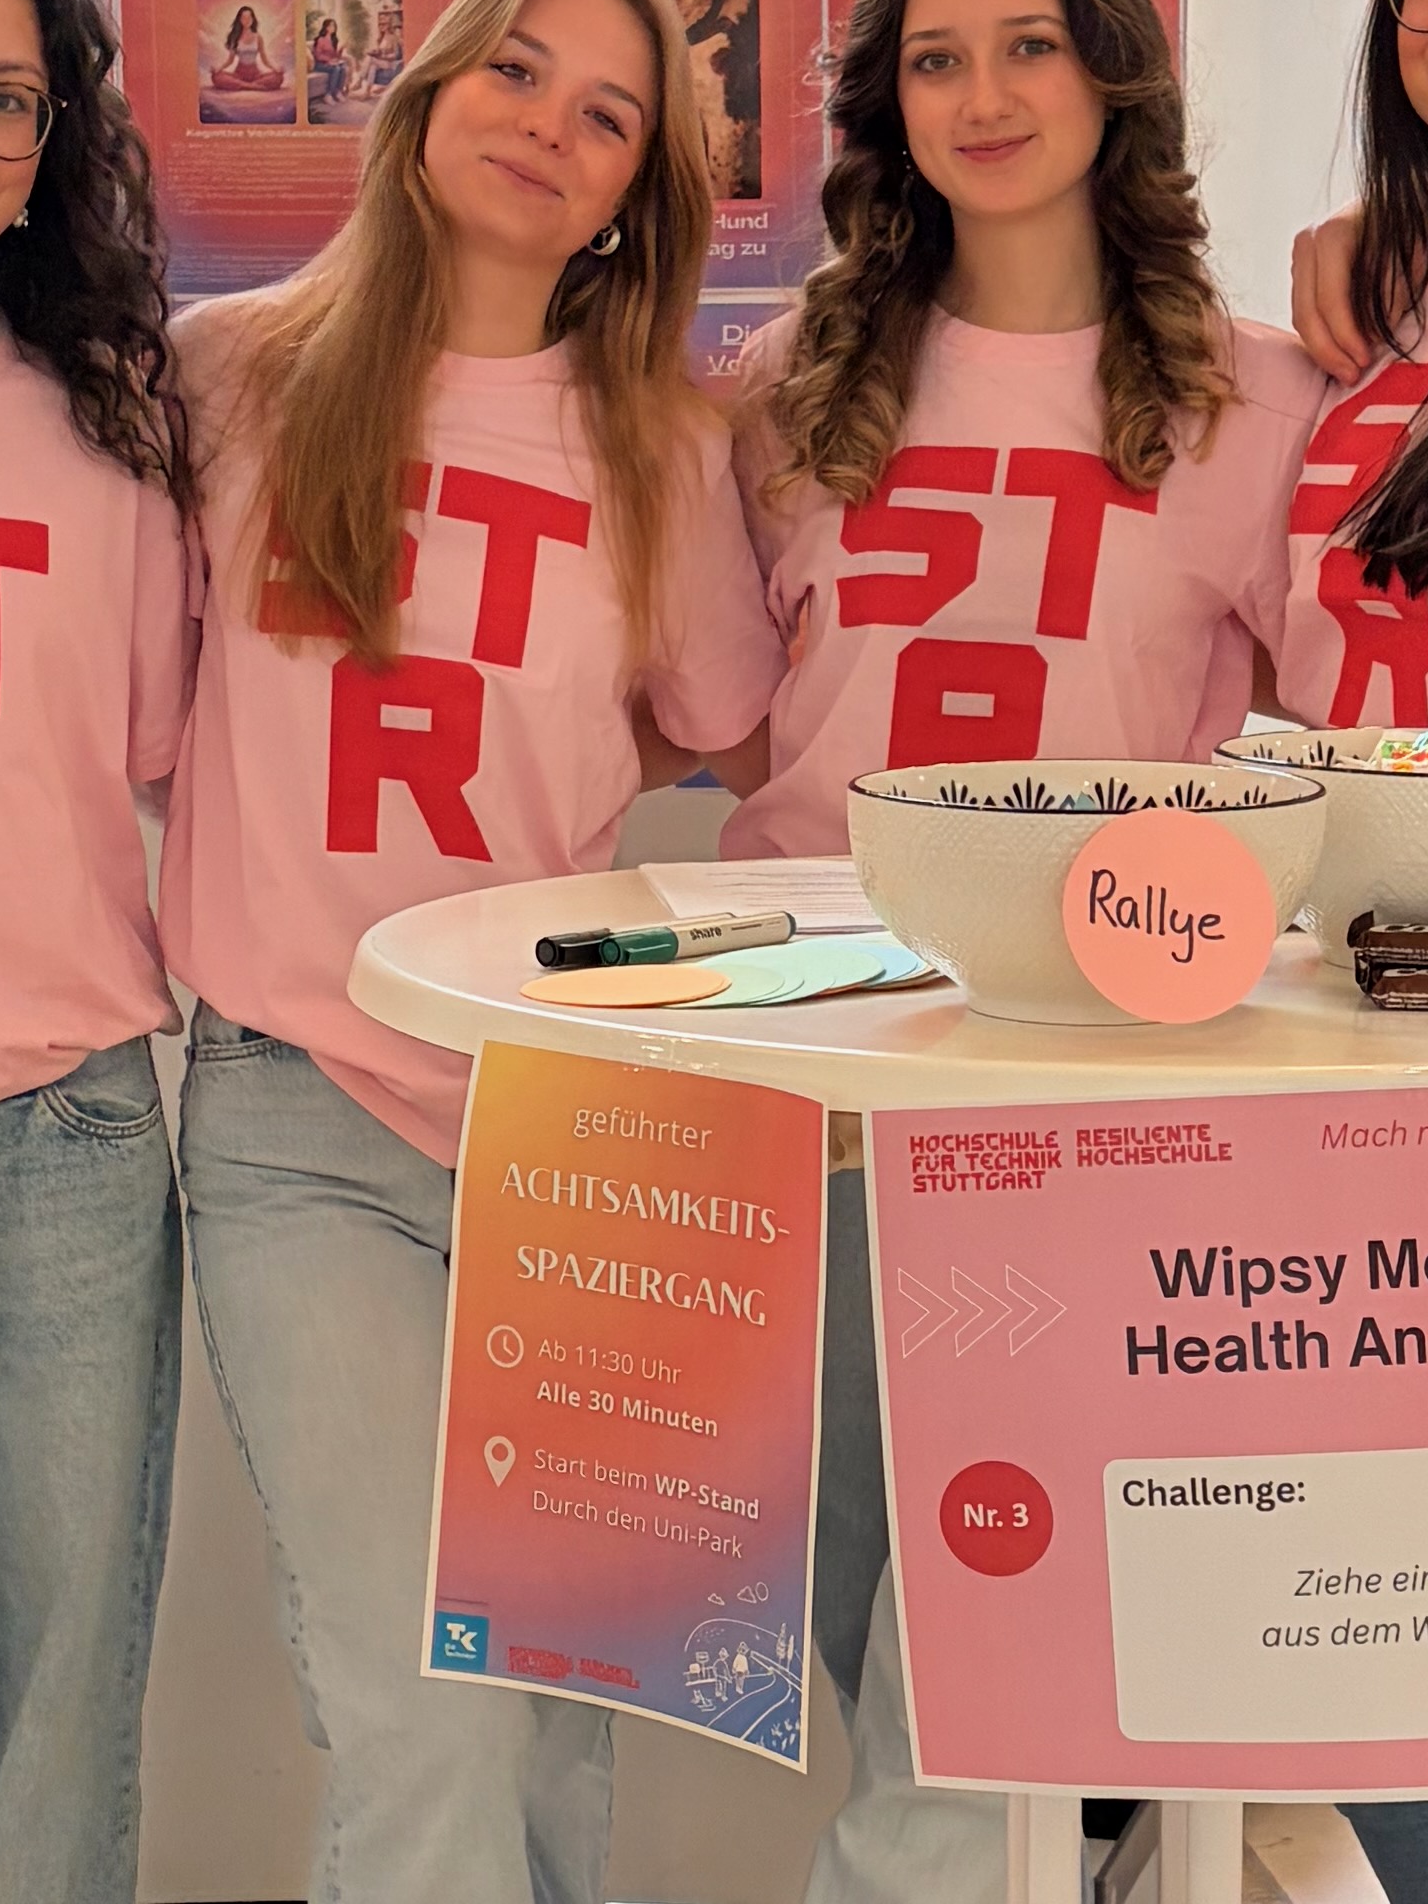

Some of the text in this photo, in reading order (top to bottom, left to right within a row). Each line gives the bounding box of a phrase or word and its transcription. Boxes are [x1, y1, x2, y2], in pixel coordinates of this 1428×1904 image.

[741, 243, 767, 255] zu
[836, 446, 1159, 640] ST
[327, 653, 493, 863] R
[1089, 868, 1225, 963] Rallye
[573, 1107, 712, 1150] geführter
[910, 1130, 1058, 1154] HOCHSCHULE
[1076, 1123, 1212, 1148] RESILIENTE
[1321, 1119, 1407, 1150] Mach
[912, 1150, 1063, 1173] FÜR TECHNIK
[1077, 1142, 1232, 1167] HOCHSCHULE
[501, 1162, 790, 1244] ACHTSAMKEITS-
[913, 1170, 1046, 1193] STUTTGART
[517, 1246, 766, 1326] SPAZIERGANG
[1149, 1246, 1347, 1309] Wipsy
[538, 1339, 682, 1384] Ab 11:30 Uhr
[1126, 1319, 1330, 1376] Health
[536, 1381, 718, 1437] Alle 30 Minuten
[534, 1448, 760, 1519] Start beim WP-Stand
[1122, 1477, 1306, 1512] Challenge:
[532, 1490, 742, 1559] Durch den Uni-Park
[963, 1503, 1030, 1528] Nr. 3
[1294, 1566, 1382, 1597] Ziehe
[1262, 1623, 1321, 1647] aus
[1331, 1618, 1401, 1646] dem
